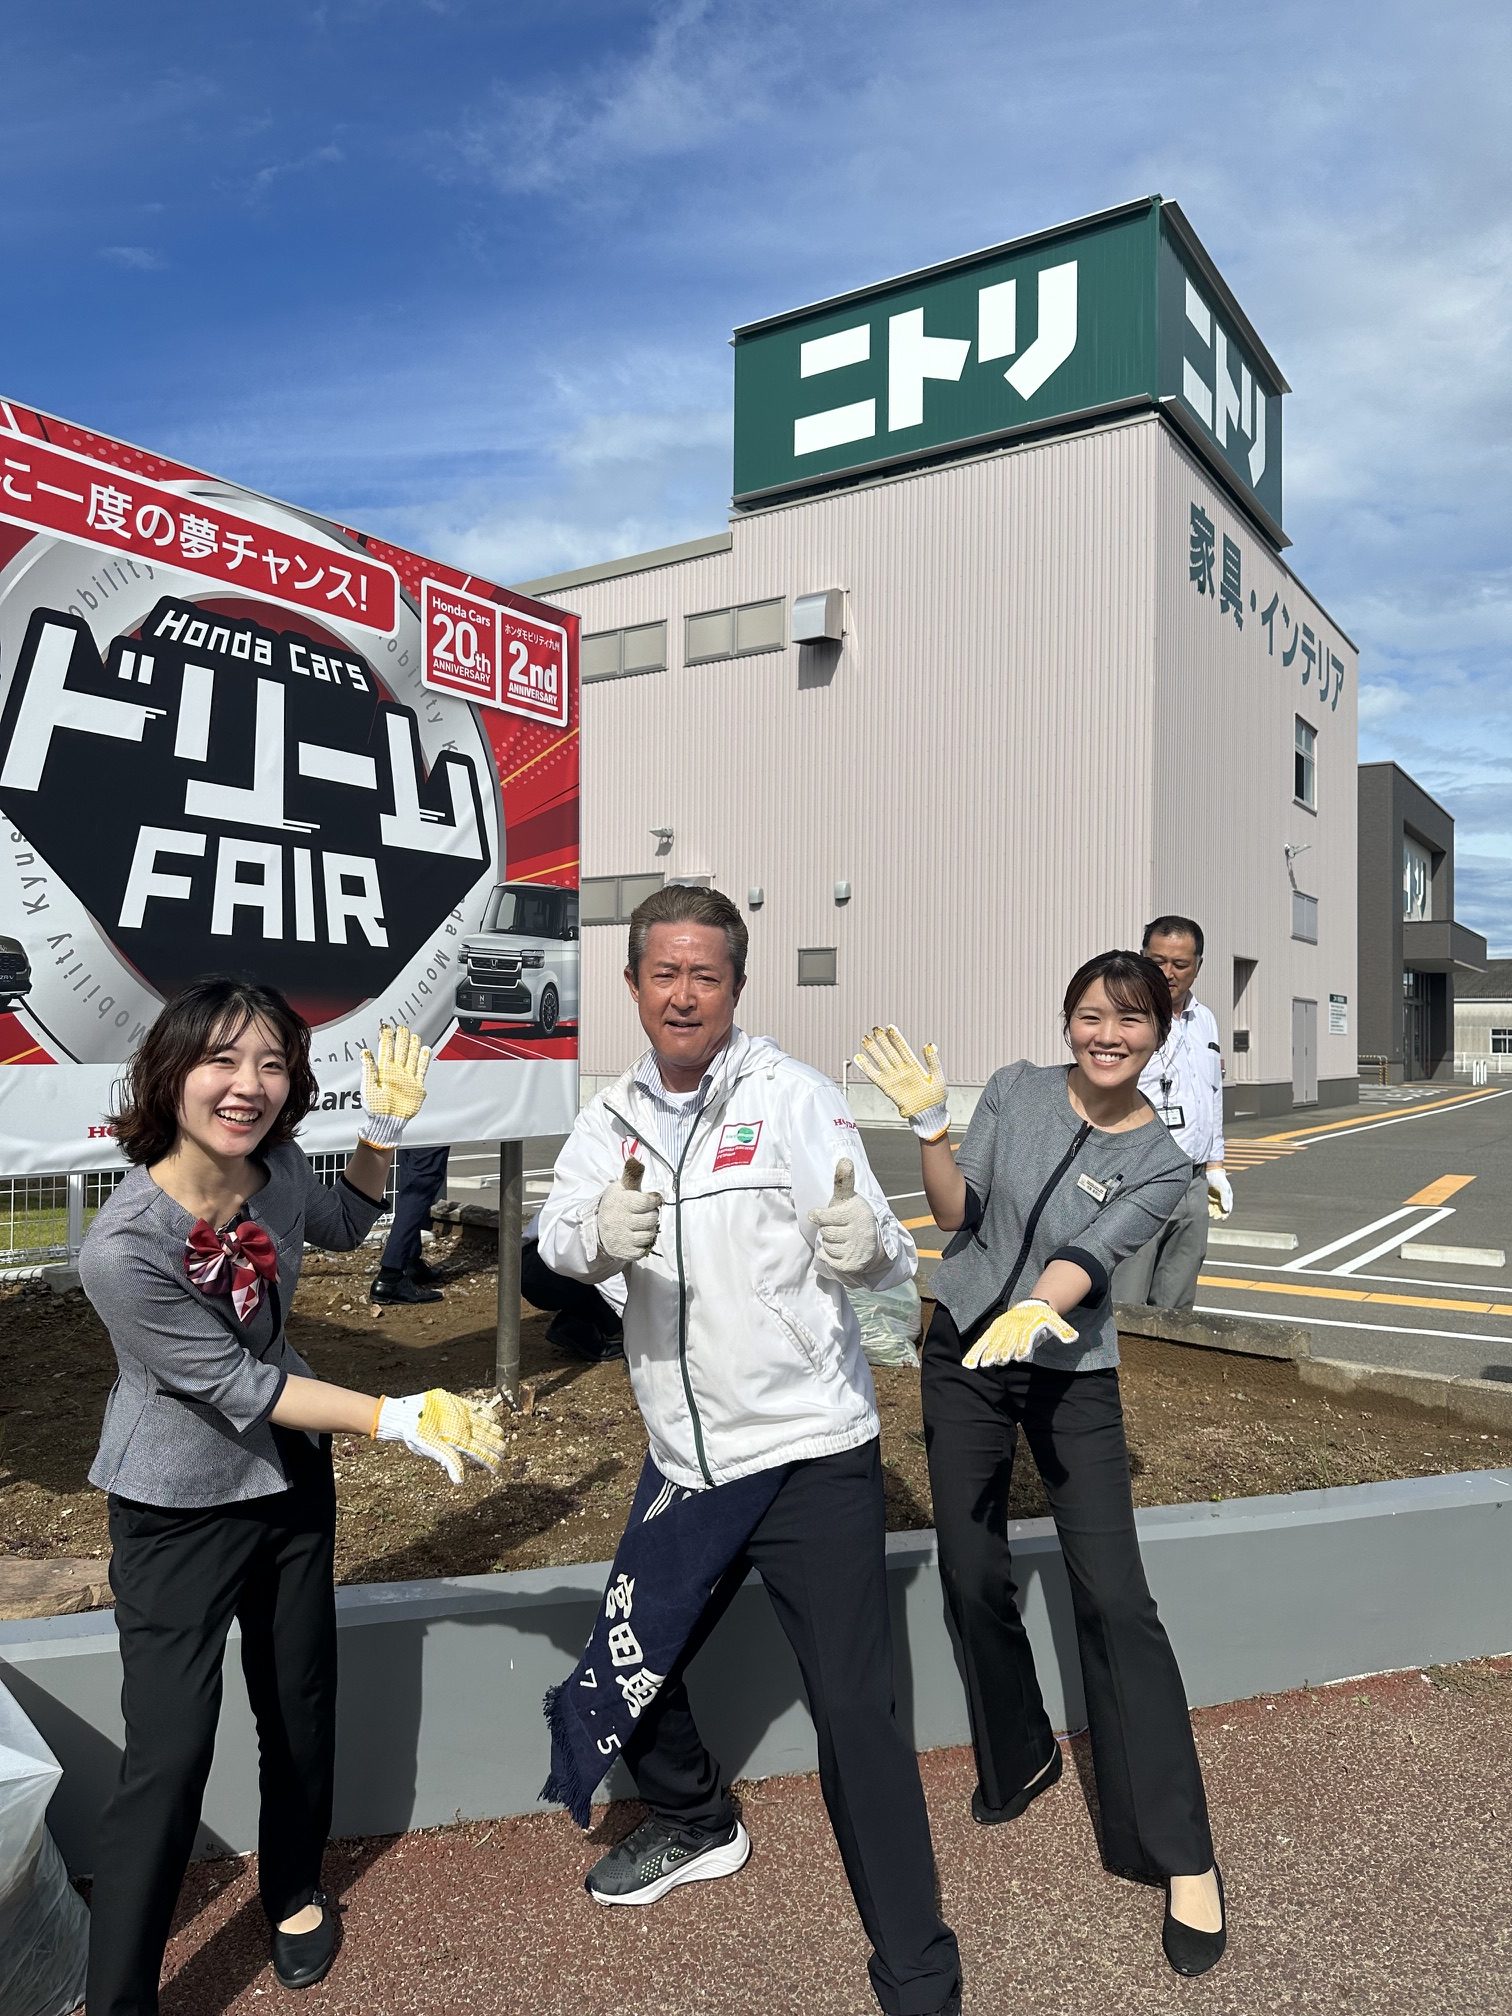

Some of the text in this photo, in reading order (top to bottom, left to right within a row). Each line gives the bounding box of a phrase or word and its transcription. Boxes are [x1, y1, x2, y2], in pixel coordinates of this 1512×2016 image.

[794, 260, 1077, 456] ニトリ
[1183, 277, 1265, 488] ニトリ
[69, 559, 155, 619] obility
[433, 596, 491, 627] Honda Cars
[1189, 501, 1344, 711] 家具・インテリア
[154, 610, 370, 692] Honda Cars
[433, 613, 491, 675] 20th
[505, 624, 560, 652] ホンダモビリティ九州
[509, 640, 557, 694] 2nd
[386, 638, 443, 724] obility
[433, 659, 491, 684] ANNIVERSARY
[509, 682, 557, 705] ANNIVERSARY
[0, 622, 484, 860] ドリーム
[118, 825, 389, 948] FAIR
[310, 1090, 363, 1112] ars
